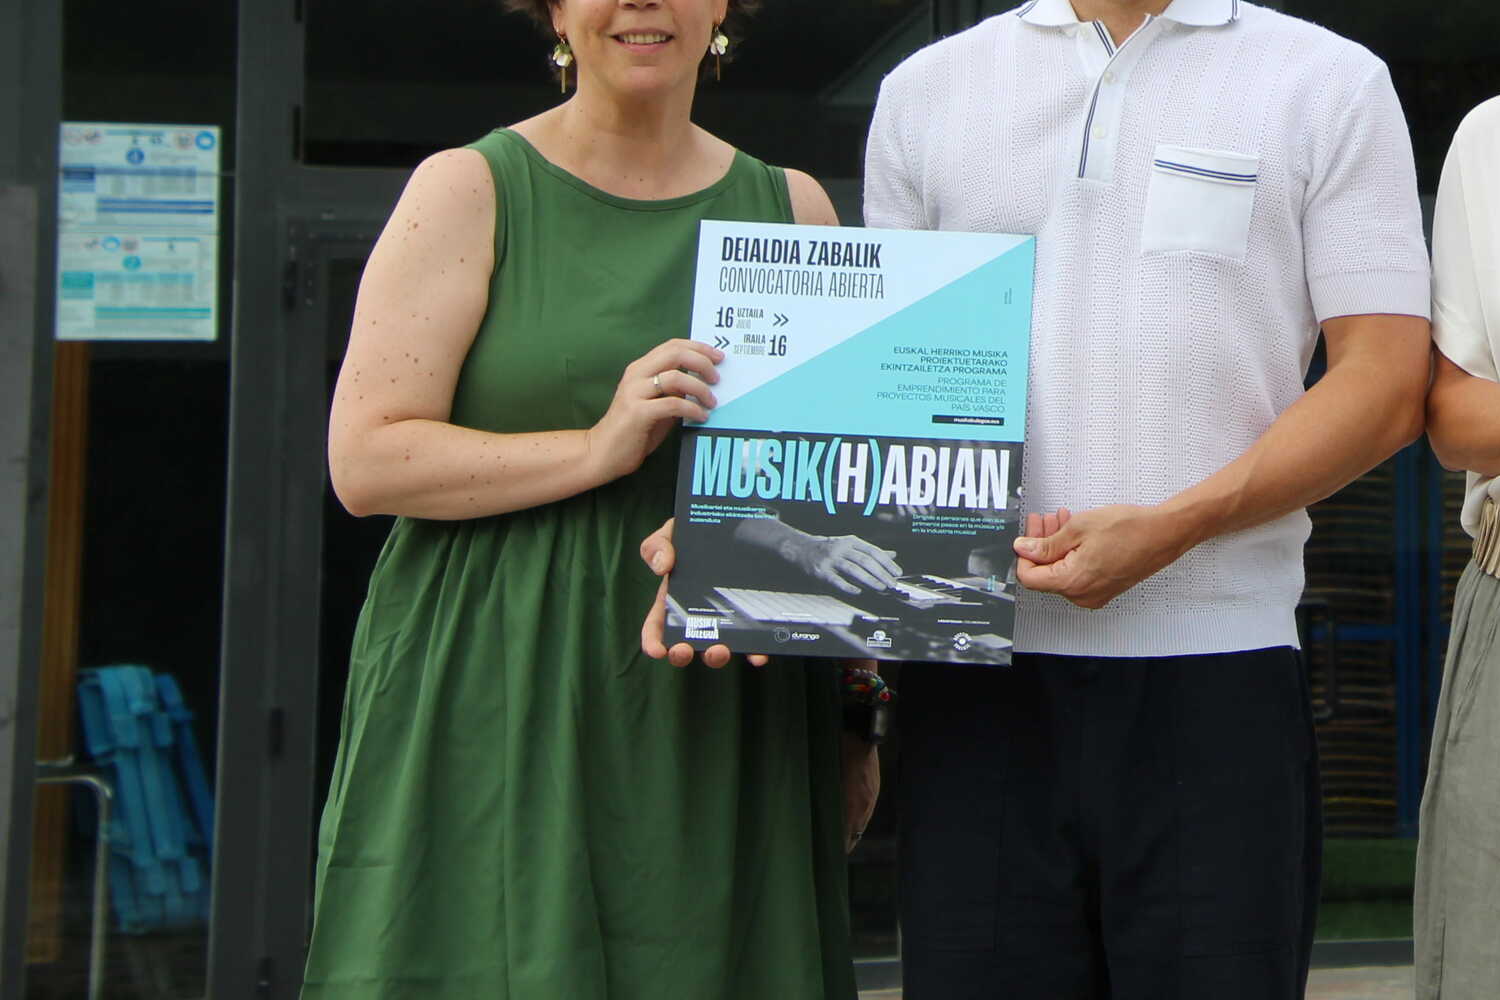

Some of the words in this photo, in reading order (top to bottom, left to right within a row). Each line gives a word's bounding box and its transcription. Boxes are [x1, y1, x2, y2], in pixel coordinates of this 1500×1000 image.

[721, 236, 800, 265] DEIALDIA
[807, 240, 882, 268] ZABALIK
[719, 266, 823, 296] CONVOCATORIA
[828, 271, 884, 299] ABIERTA
[715, 306, 734, 328] 16
[736, 307, 764, 318] UZTAILA
[743, 334, 766, 344] IRAILA
[768, 335, 787, 356] 16
[894, 346, 928, 355] EUSKAL
[931, 347, 970, 357] HERRIKO
[973, 349, 1008, 358] MUSIKA
[920, 356, 1007, 367] PROIEKTUETARAKO
[880, 363, 950, 373] EKINTZAILETZA
[953, 366, 1007, 376] PROGRAMA
[938, 377, 992, 386] PROGRAMA
[994, 379, 1007, 387] DE
[897, 384, 979, 394] EMPRENDIMIENTO
[982, 387, 1006, 396] PARA
[877, 391, 932, 401] PROYECTOS
[934, 394, 986, 404] MUSICALES
[988, 396, 1005, 404] DEL
[973, 404, 1005, 413] VASCO
[691, 435, 1010, 515] MUSIK(H)ABIAN
